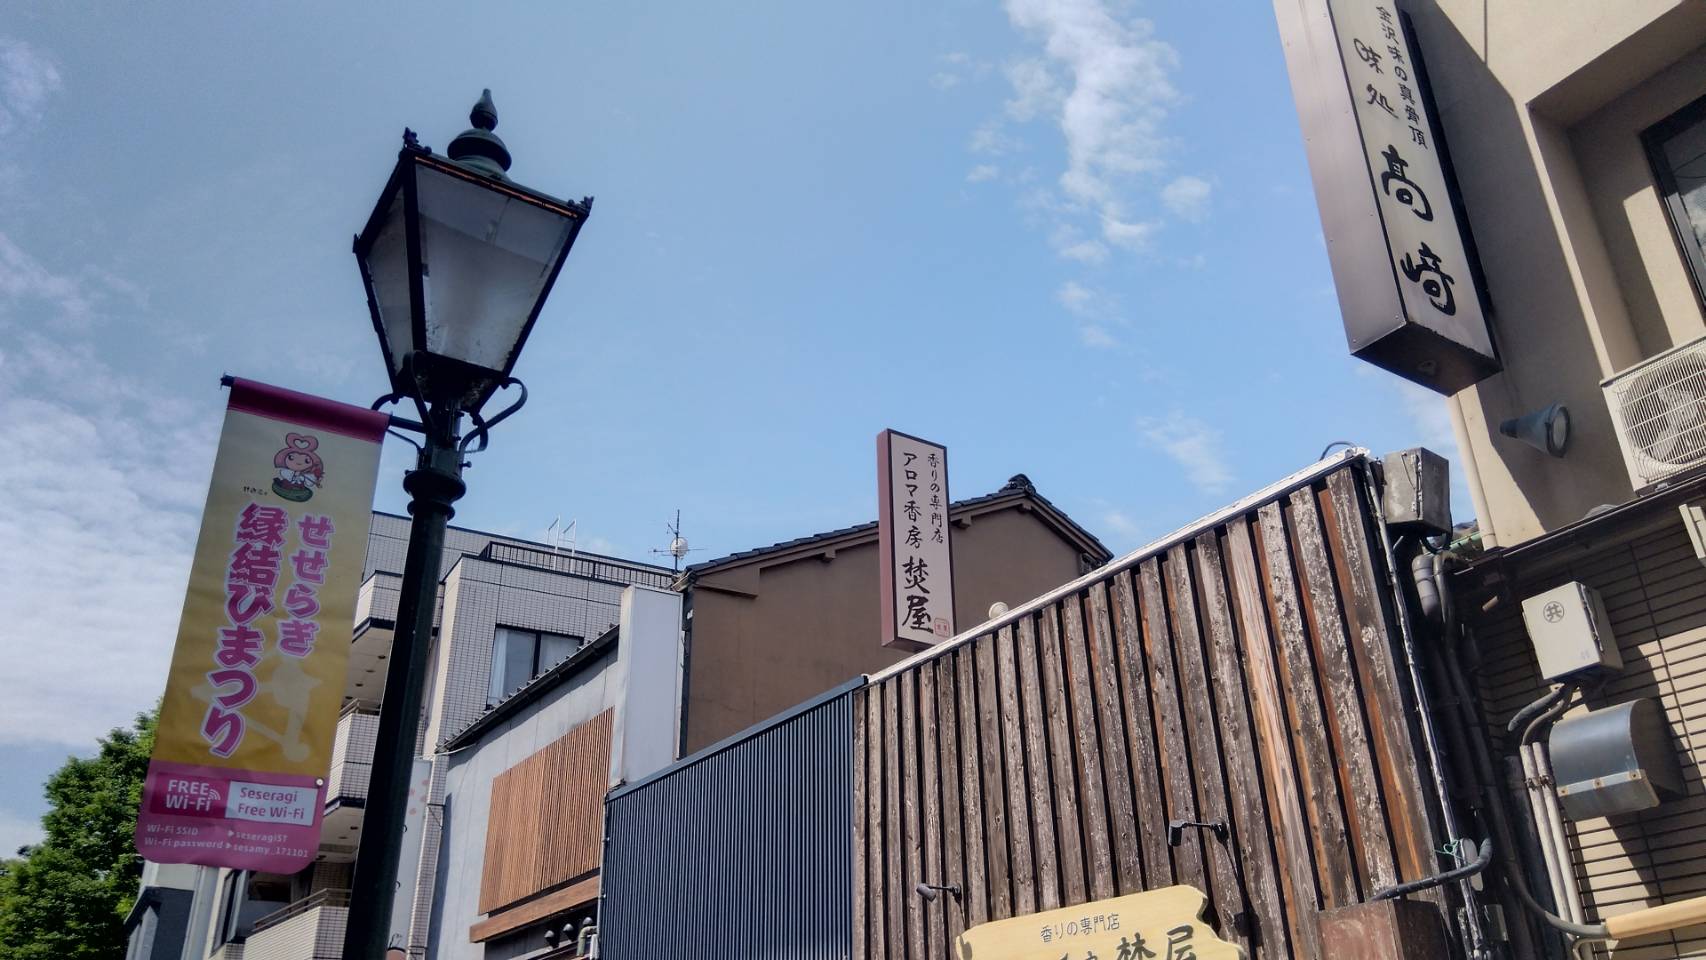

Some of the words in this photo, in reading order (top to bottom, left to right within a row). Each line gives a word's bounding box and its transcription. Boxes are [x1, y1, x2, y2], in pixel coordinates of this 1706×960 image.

[903, 452, 922, 549] アロマ香房
[927, 453, 944, 544] 香りの専門店
[277, 514, 335, 658] せせらぎ
[202, 501, 288, 757] 縁結びまつり
[168, 779, 210, 796] FREE
[240, 787, 298, 805] Seseragi
[165, 794, 212, 812] Wi-Fi
[238, 804, 267, 817] Free
[269, 806, 304, 820] Wi-Fi
[146, 824, 174, 834] Wi-Fi
[175, 826, 199, 836] SSID
[144, 837, 172, 847] Wi-Fi
[173, 839, 224, 850] password
[1041, 913, 1120, 943] 香りの専門店
